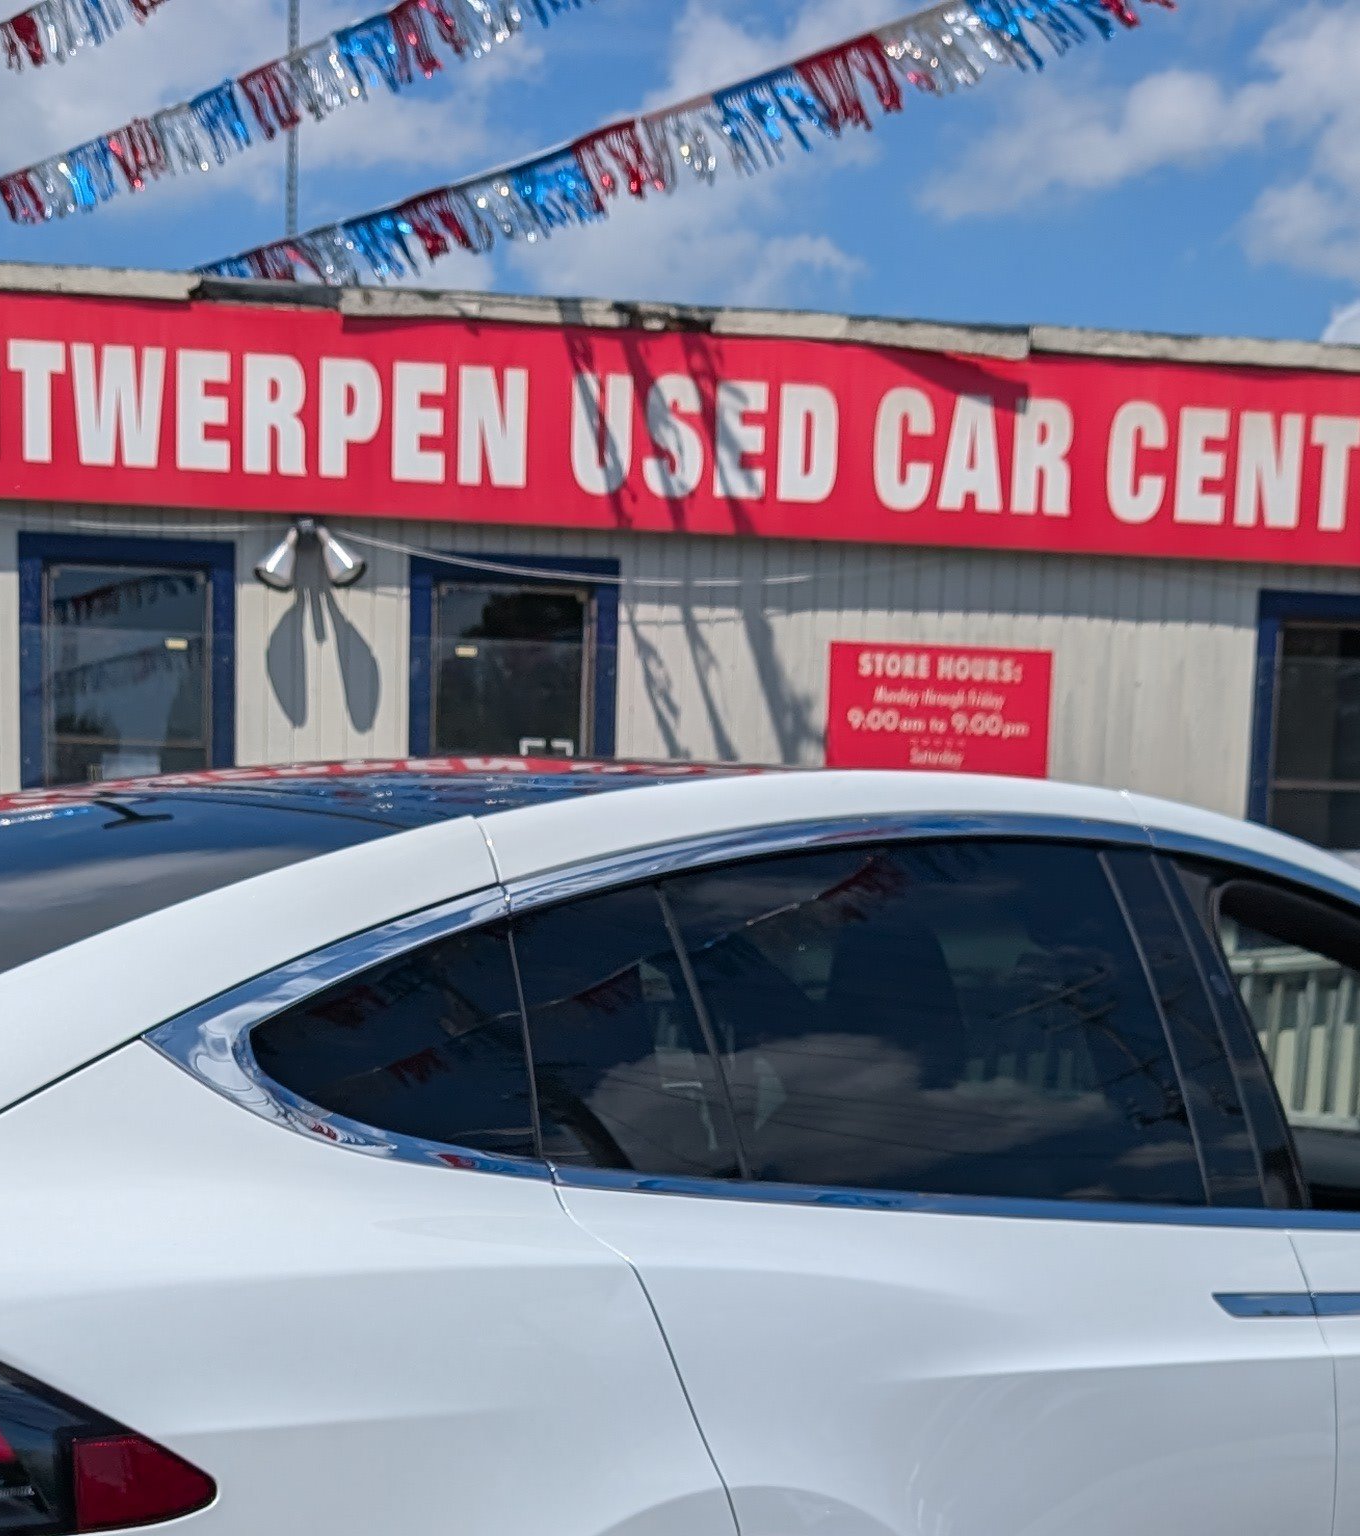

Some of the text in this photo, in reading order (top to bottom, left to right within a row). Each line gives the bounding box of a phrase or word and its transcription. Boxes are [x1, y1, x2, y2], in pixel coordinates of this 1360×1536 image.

[571, 371, 839, 503] USED
[873, 387, 1073, 517] CAR
[858, 652, 1023, 683] STORE HOURS:
